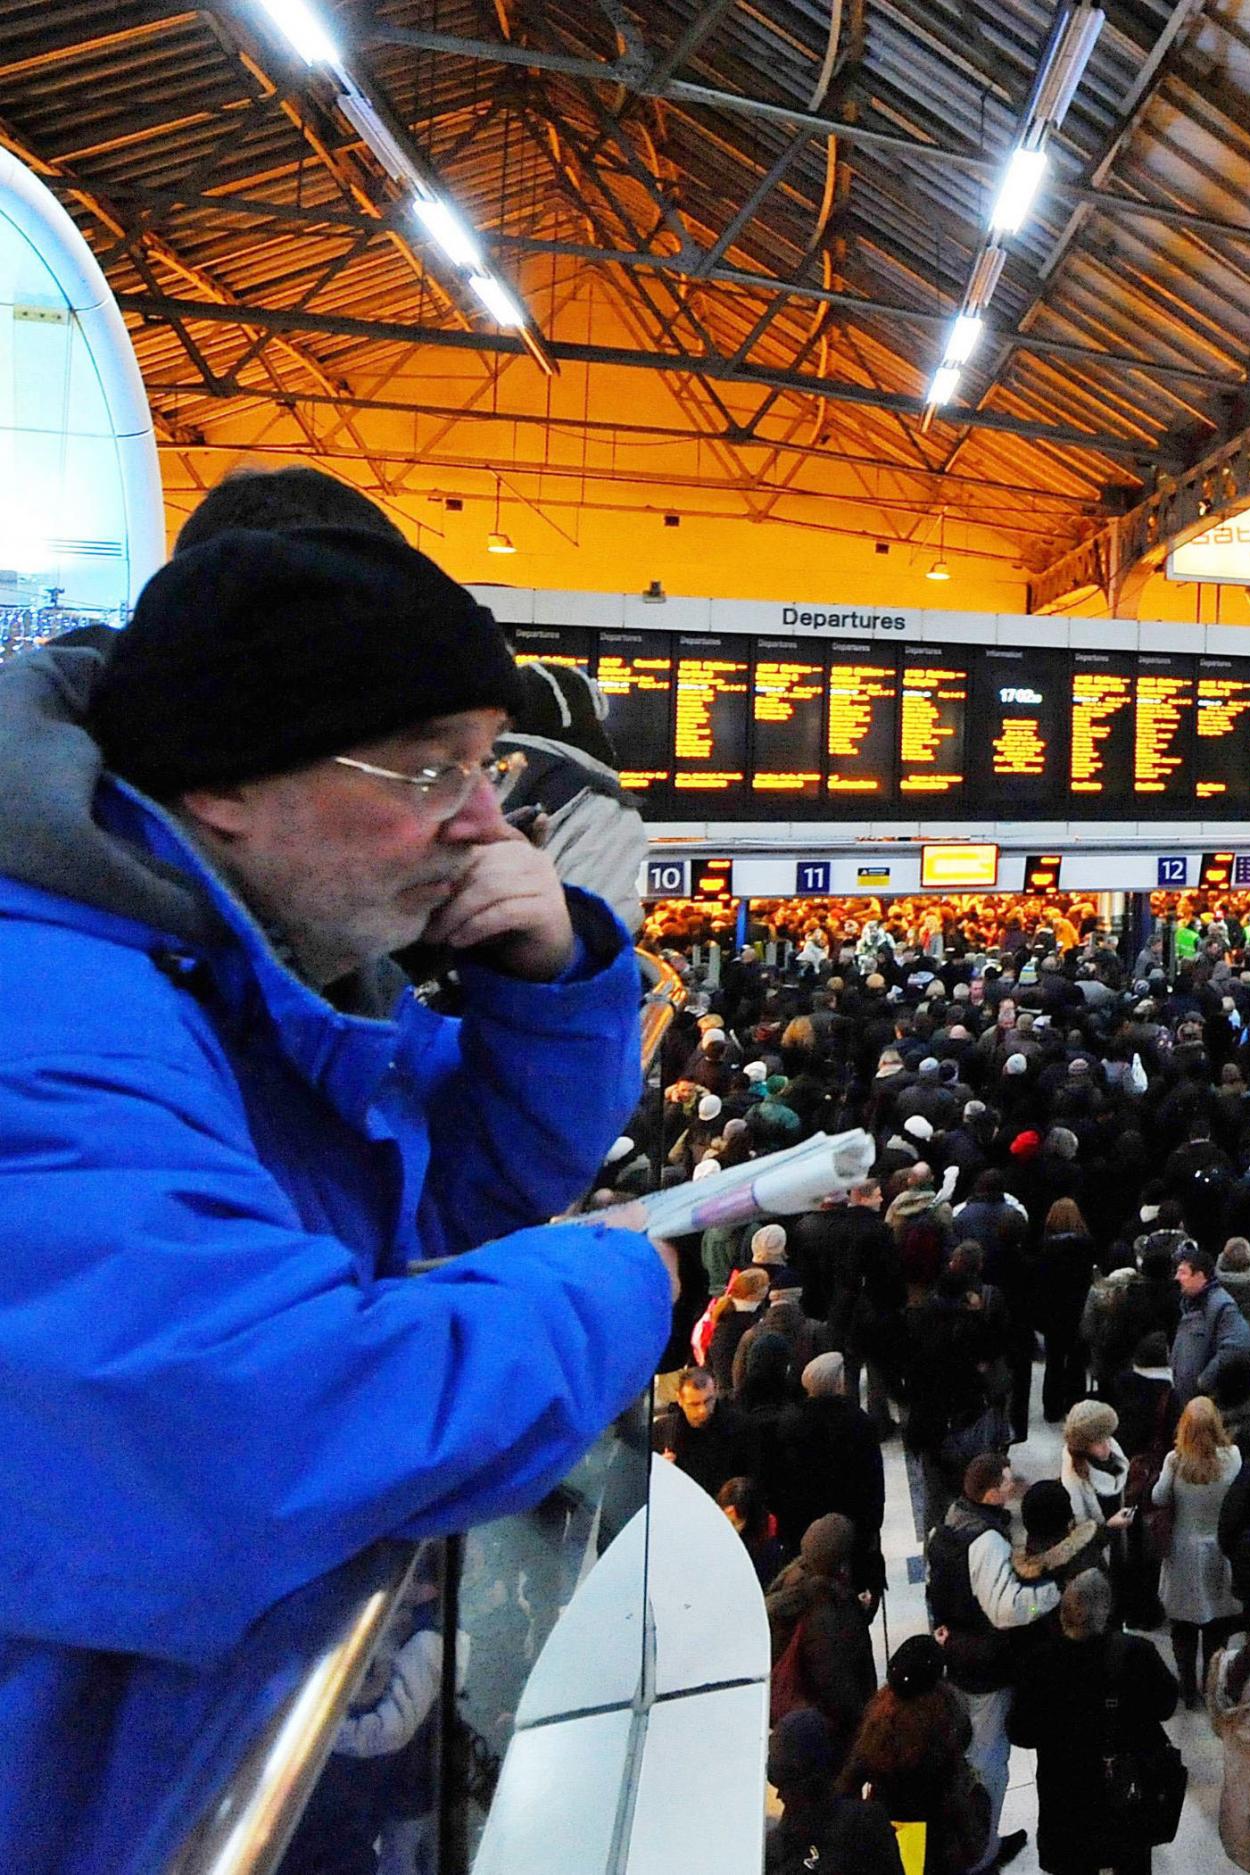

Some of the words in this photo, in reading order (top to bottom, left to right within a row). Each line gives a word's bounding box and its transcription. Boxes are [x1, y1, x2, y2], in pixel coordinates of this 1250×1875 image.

[783, 608, 906, 630] Departures
[651, 867, 681, 889] 10
[803, 867, 824, 888] 11
[1162, 860, 1184, 880] 12
